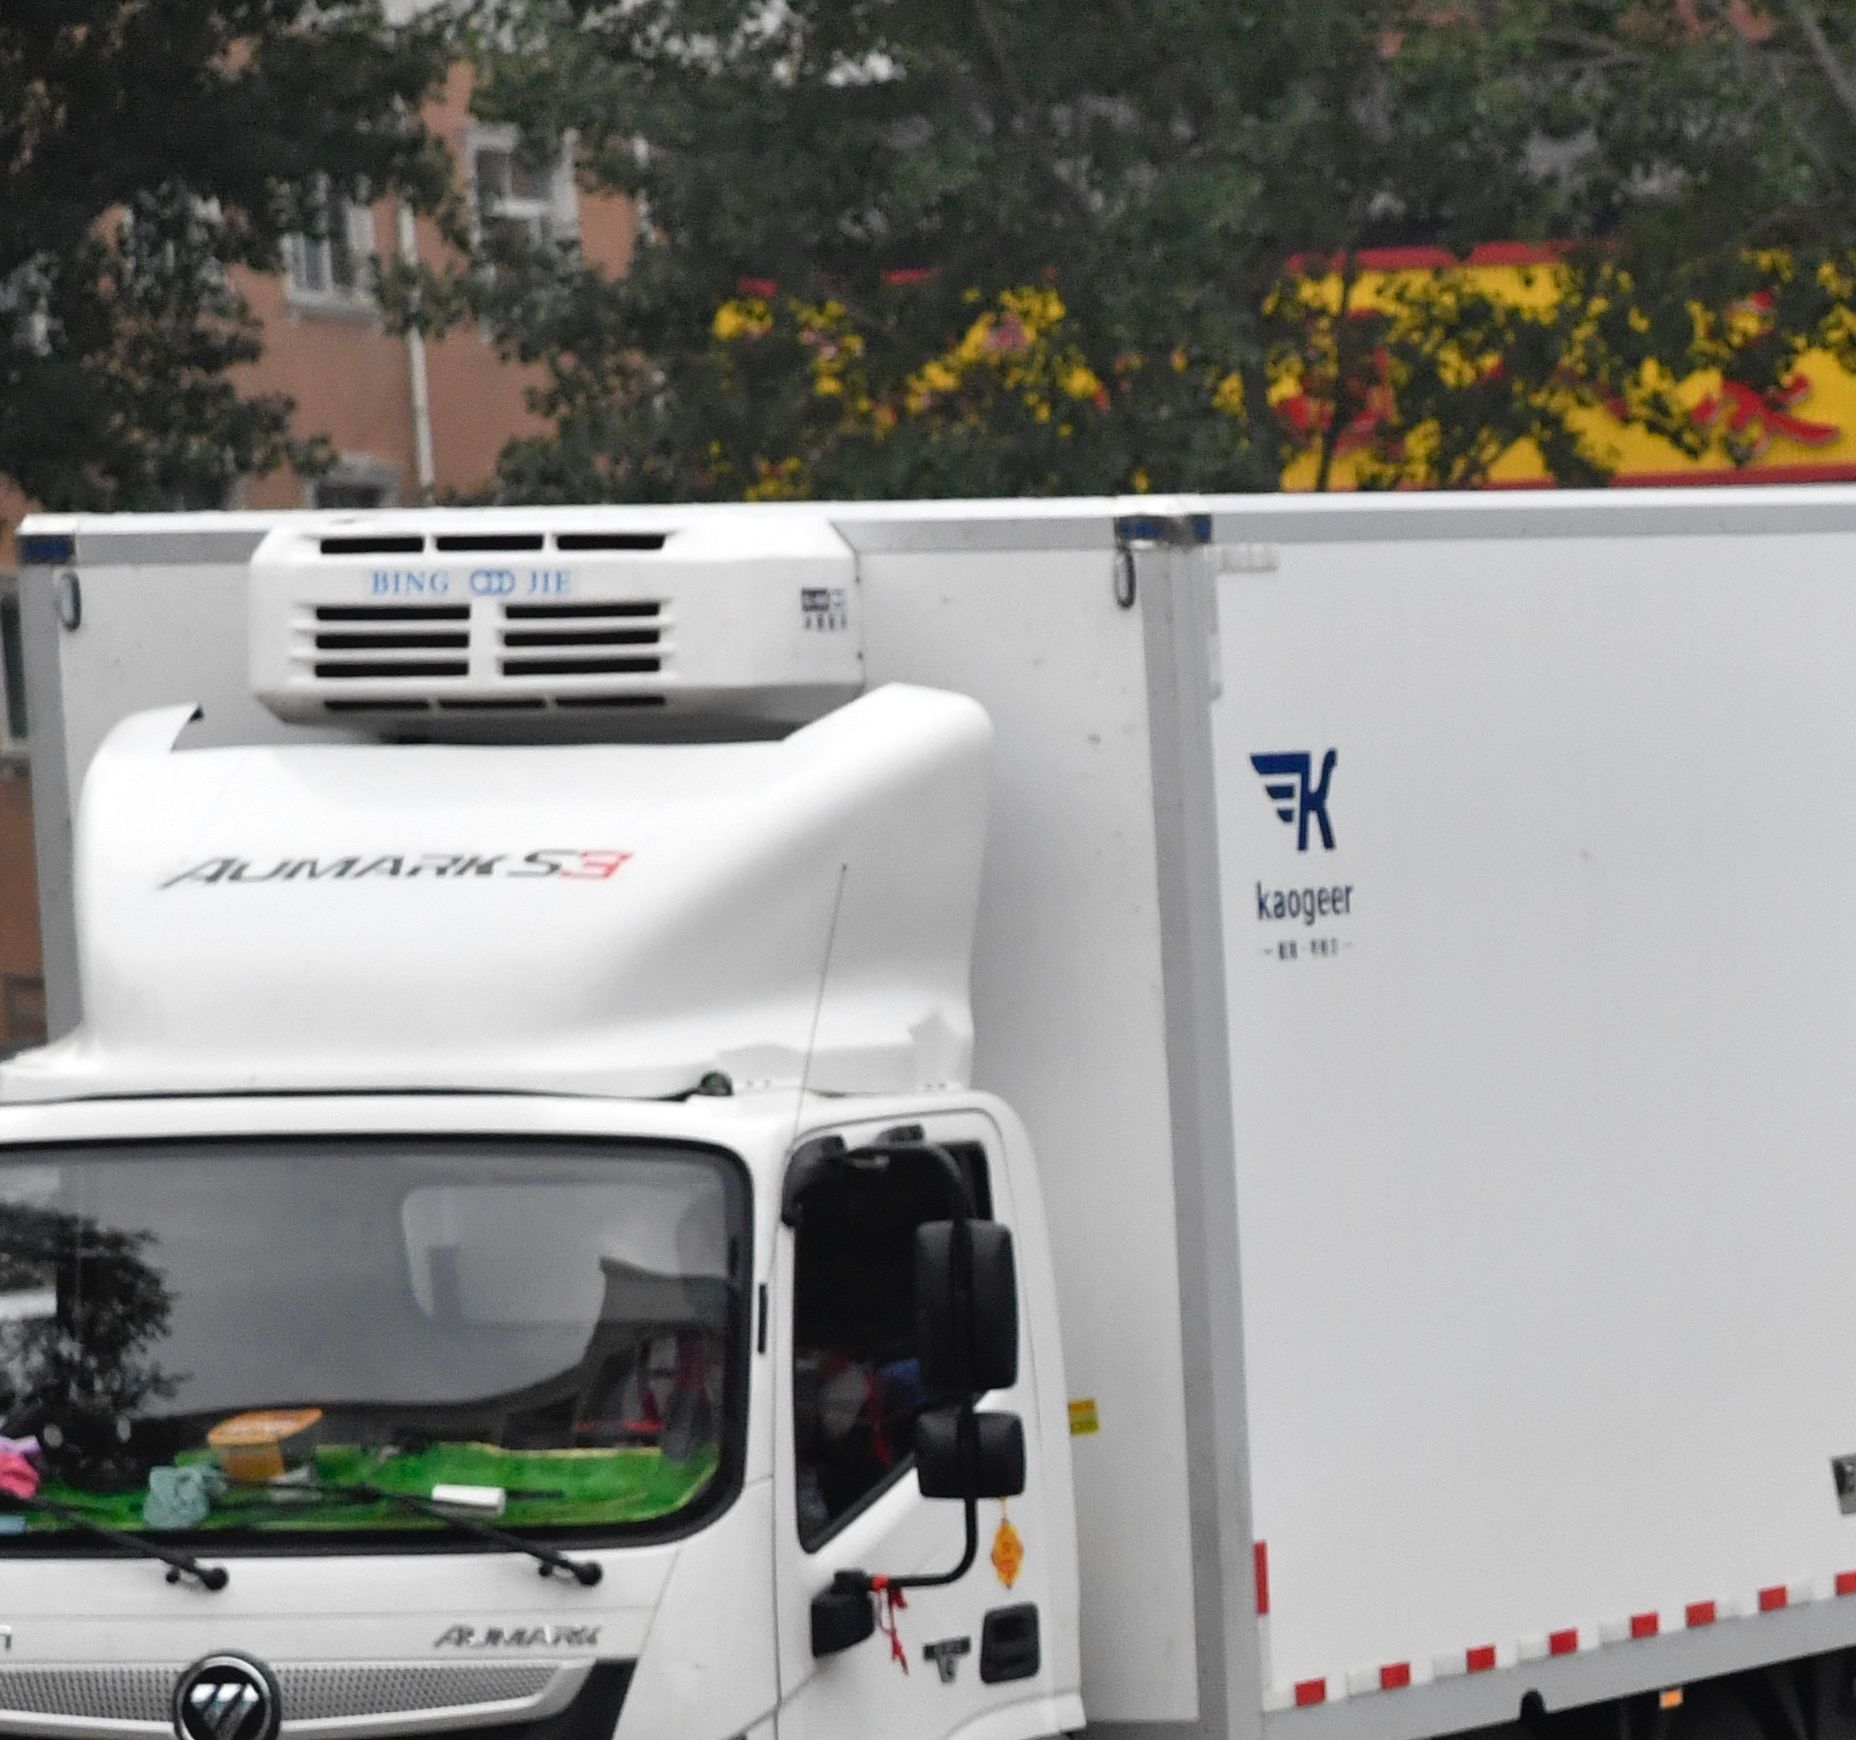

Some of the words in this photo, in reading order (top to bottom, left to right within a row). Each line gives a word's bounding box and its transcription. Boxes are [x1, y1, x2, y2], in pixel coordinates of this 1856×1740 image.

[372, 570, 449, 595] BING
[528, 570, 571, 595] JIE
[160, 855, 504, 891] AUMARK
[1257, 881, 1354, 926] kaogeer
